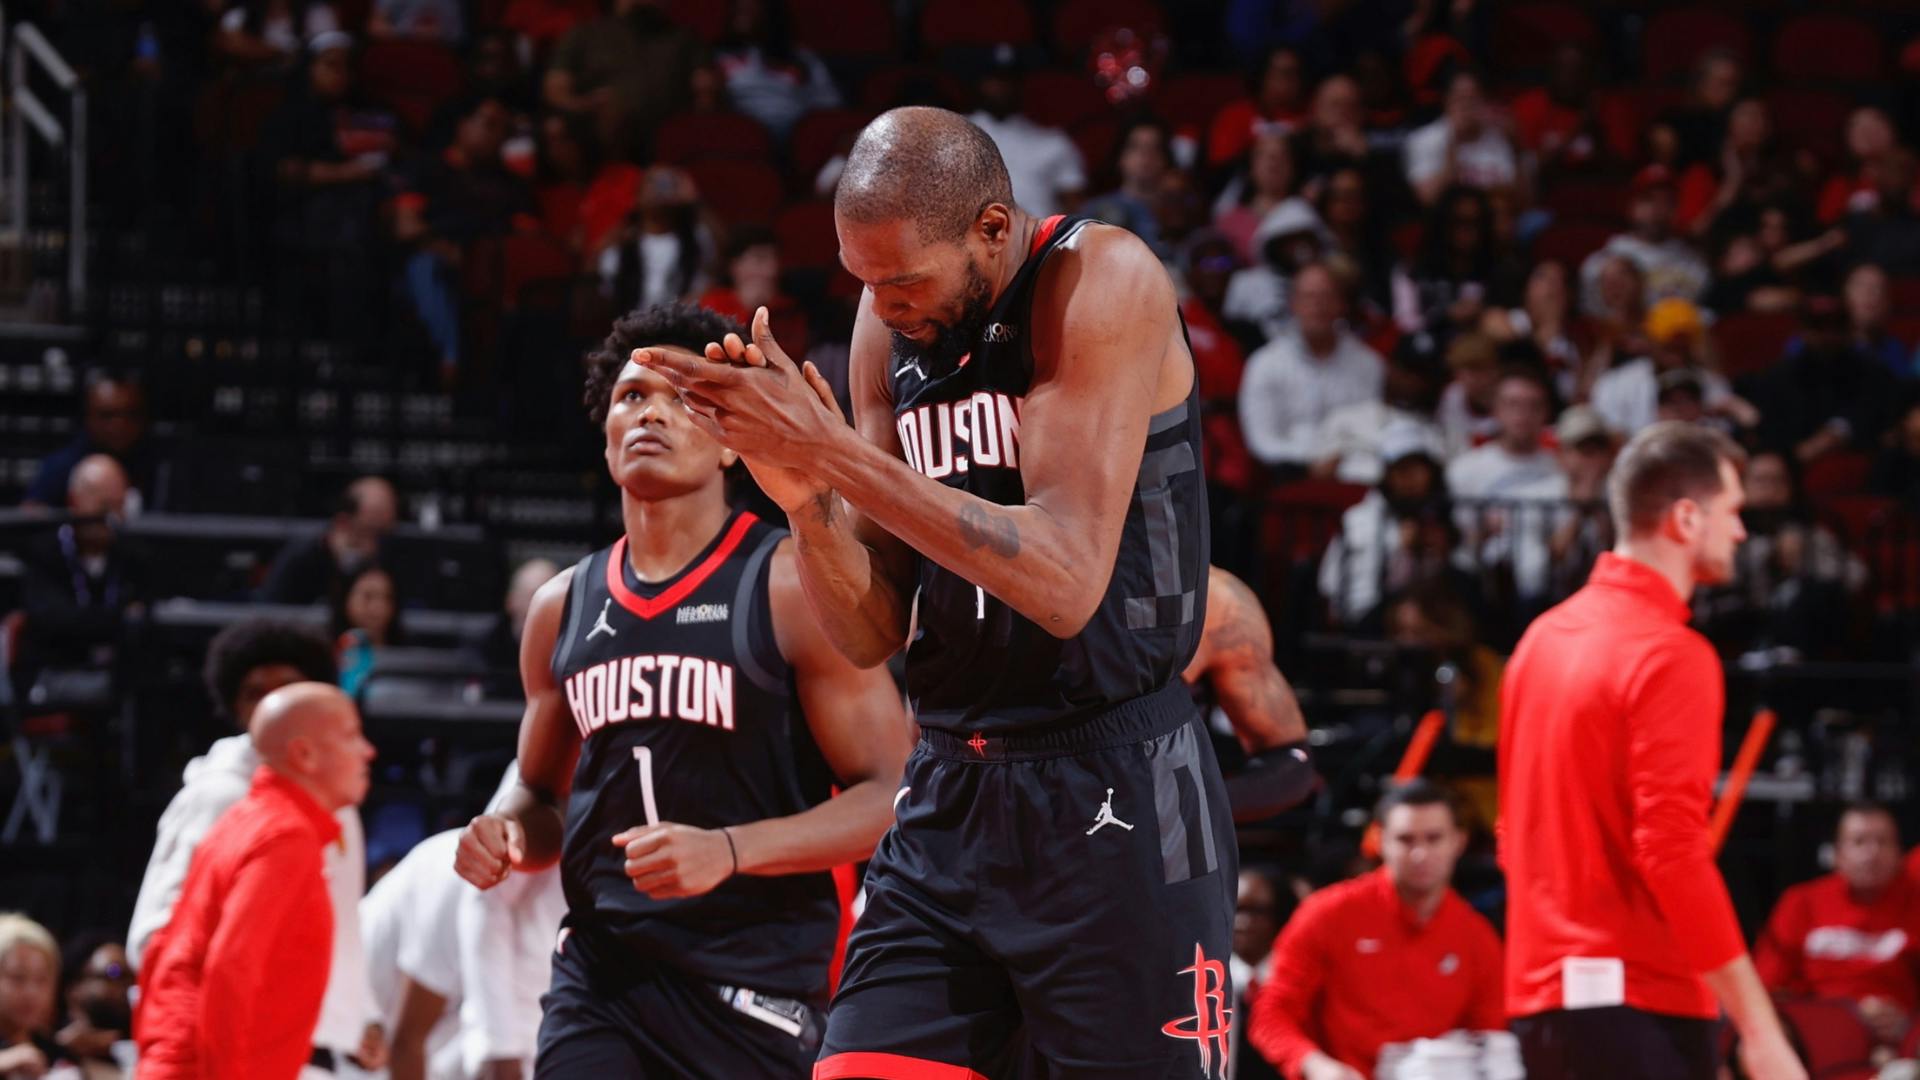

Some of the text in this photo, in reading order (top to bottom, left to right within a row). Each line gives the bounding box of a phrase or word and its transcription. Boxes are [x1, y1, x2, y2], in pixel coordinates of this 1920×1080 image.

[896, 391, 1023, 479] OUSON
[565, 654, 735, 739] HOUSTON
[632, 745, 660, 827] 1
